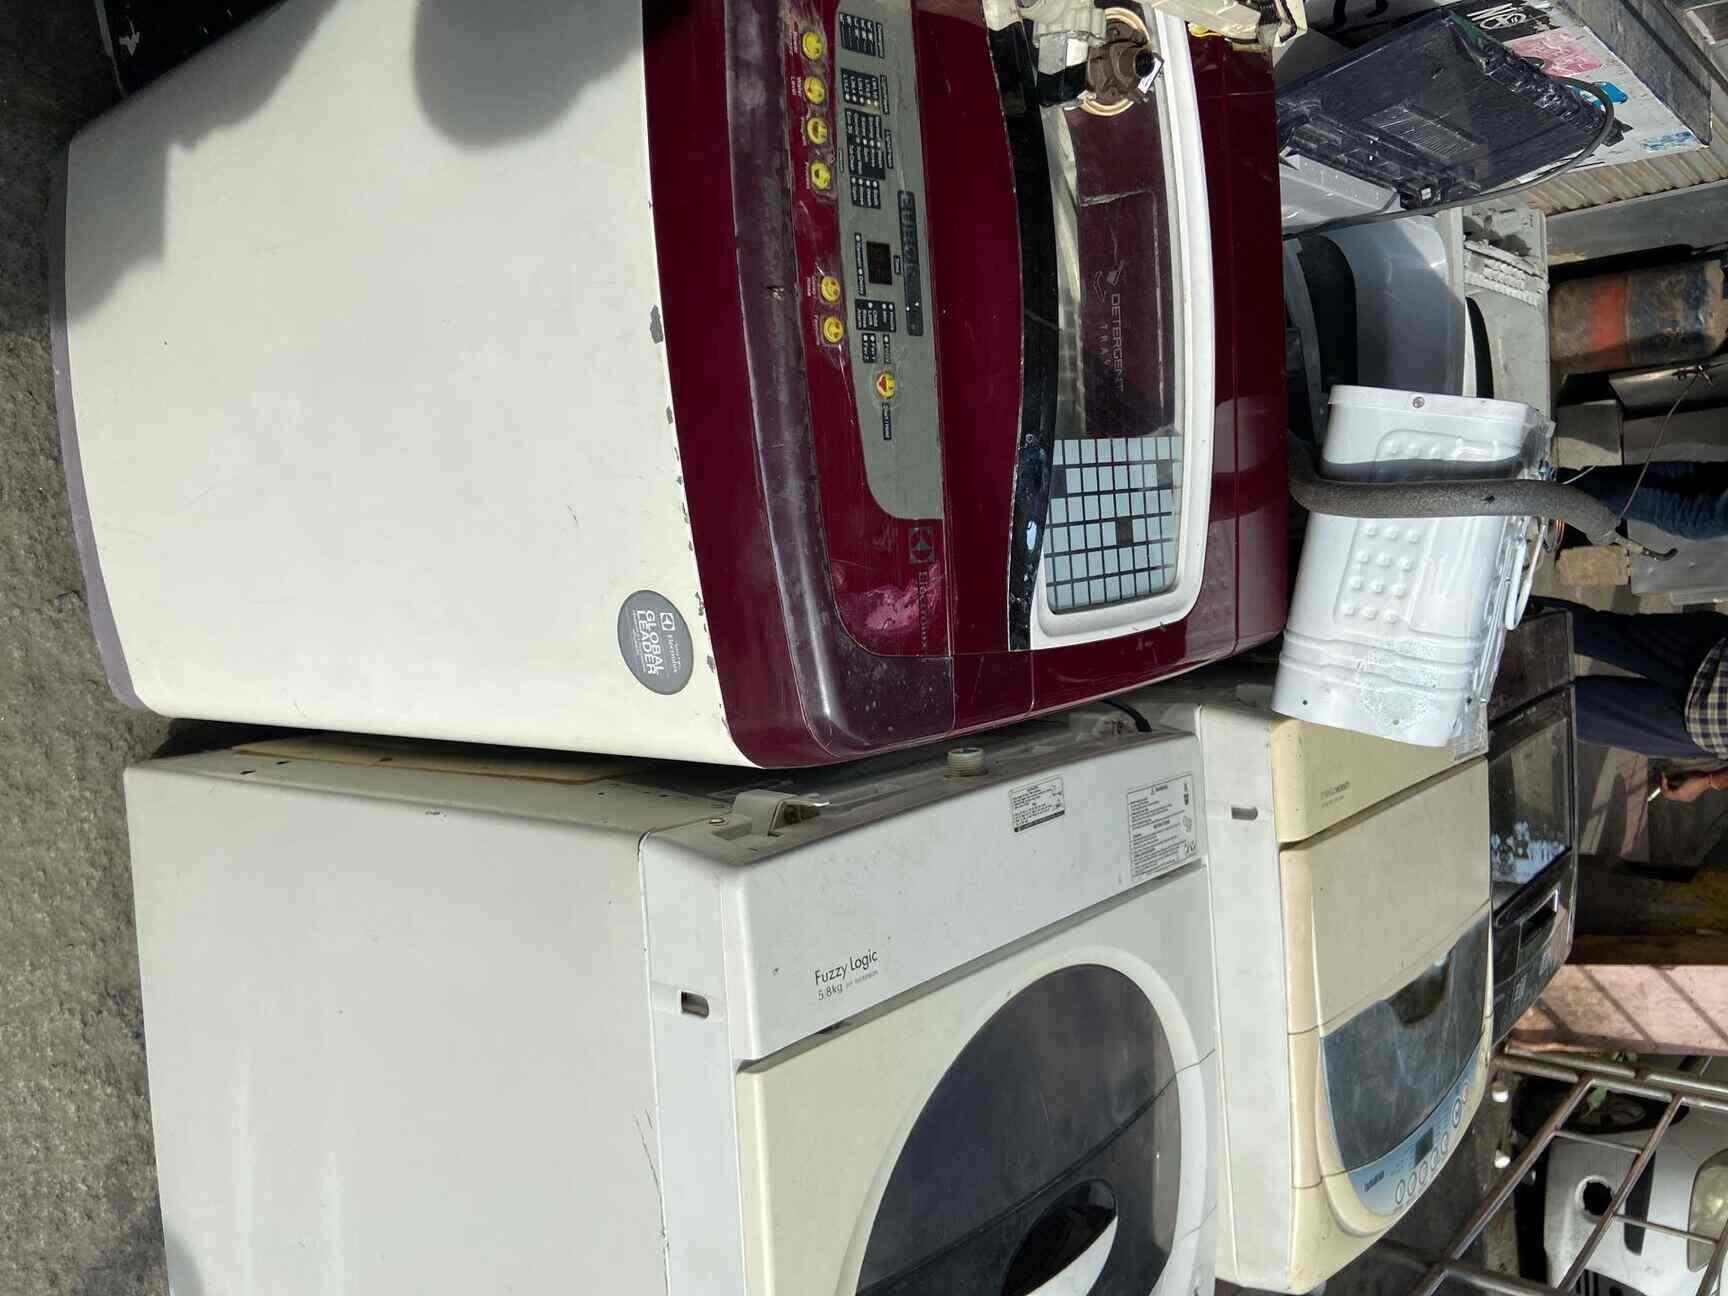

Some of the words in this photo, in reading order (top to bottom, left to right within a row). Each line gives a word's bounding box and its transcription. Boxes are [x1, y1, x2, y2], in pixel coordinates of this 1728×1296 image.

[636, 610, 657, 675] LEADER
[645, 610, 665, 676] GLOBAL
[814, 964, 848, 986] Fuzzy
[849, 948, 879, 971] Logic
